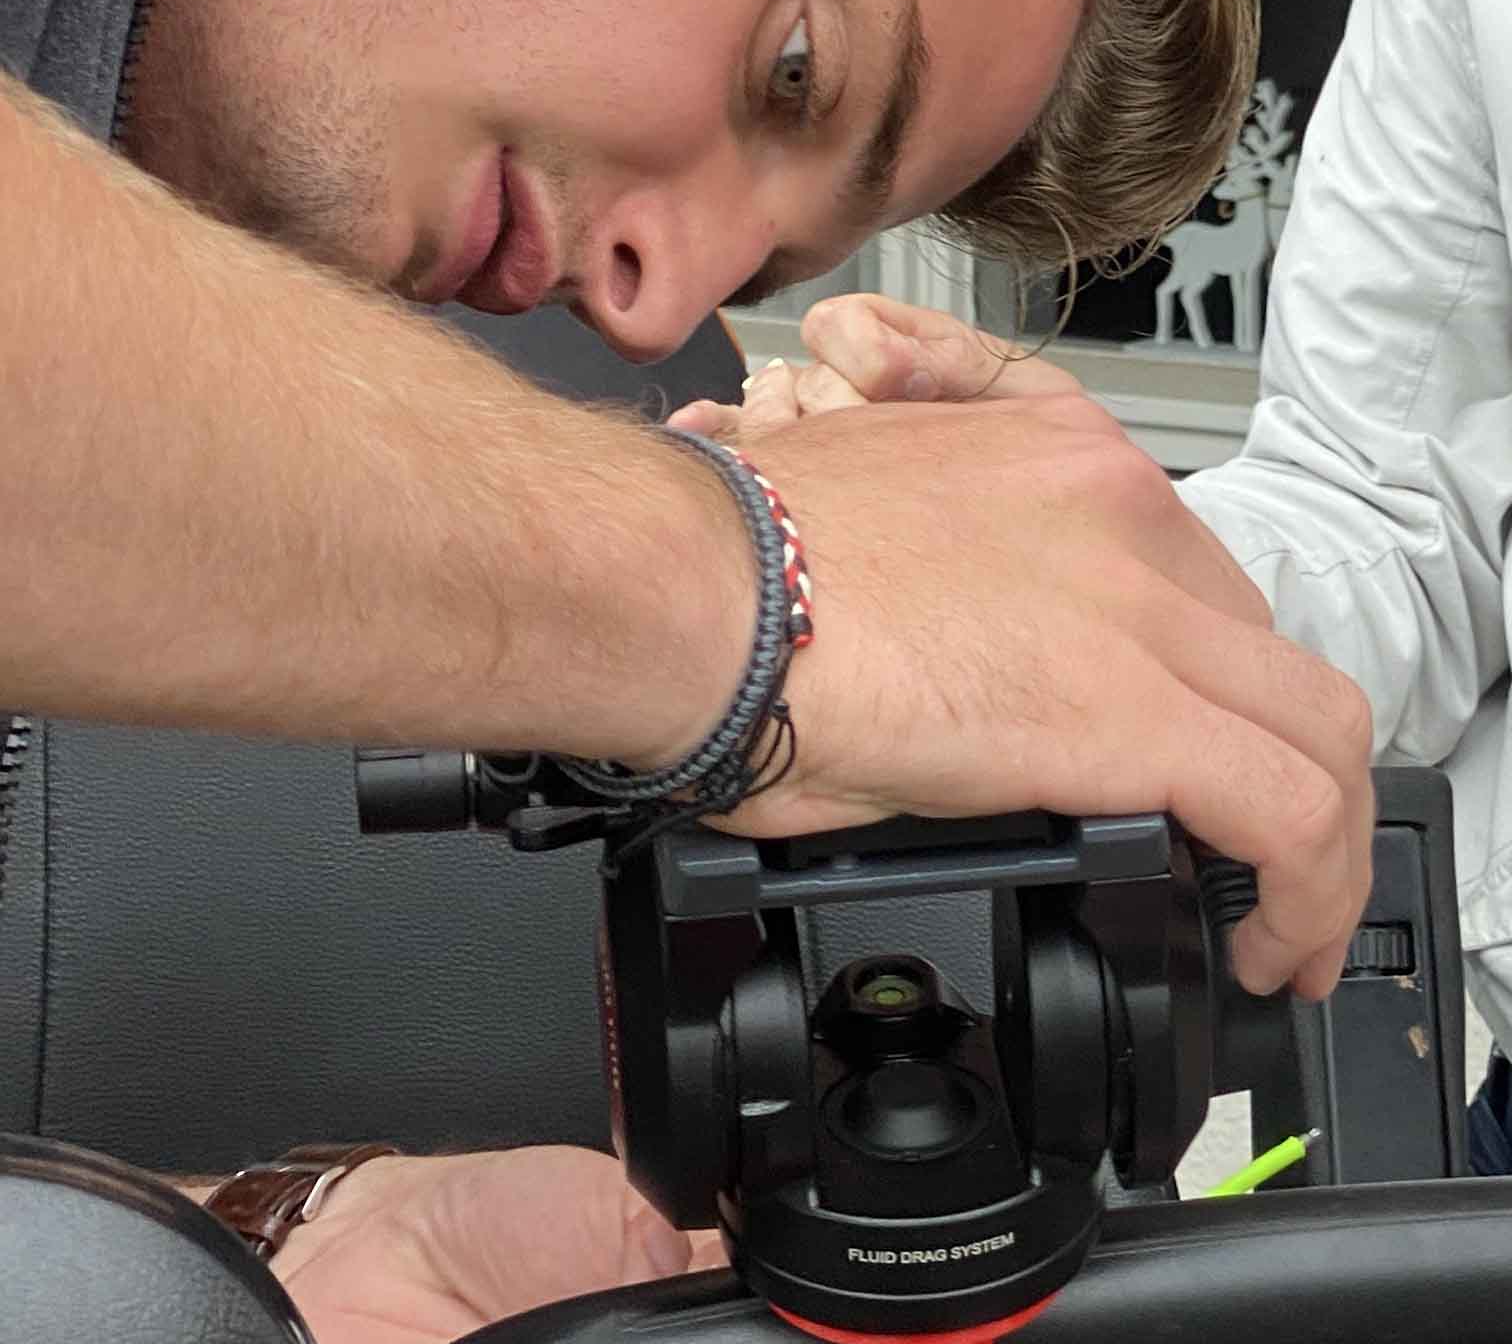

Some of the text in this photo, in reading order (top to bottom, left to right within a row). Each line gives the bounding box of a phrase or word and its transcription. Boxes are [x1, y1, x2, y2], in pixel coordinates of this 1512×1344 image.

[848, 1231, 1016, 1264] FLUID DRAG SYSTEM
